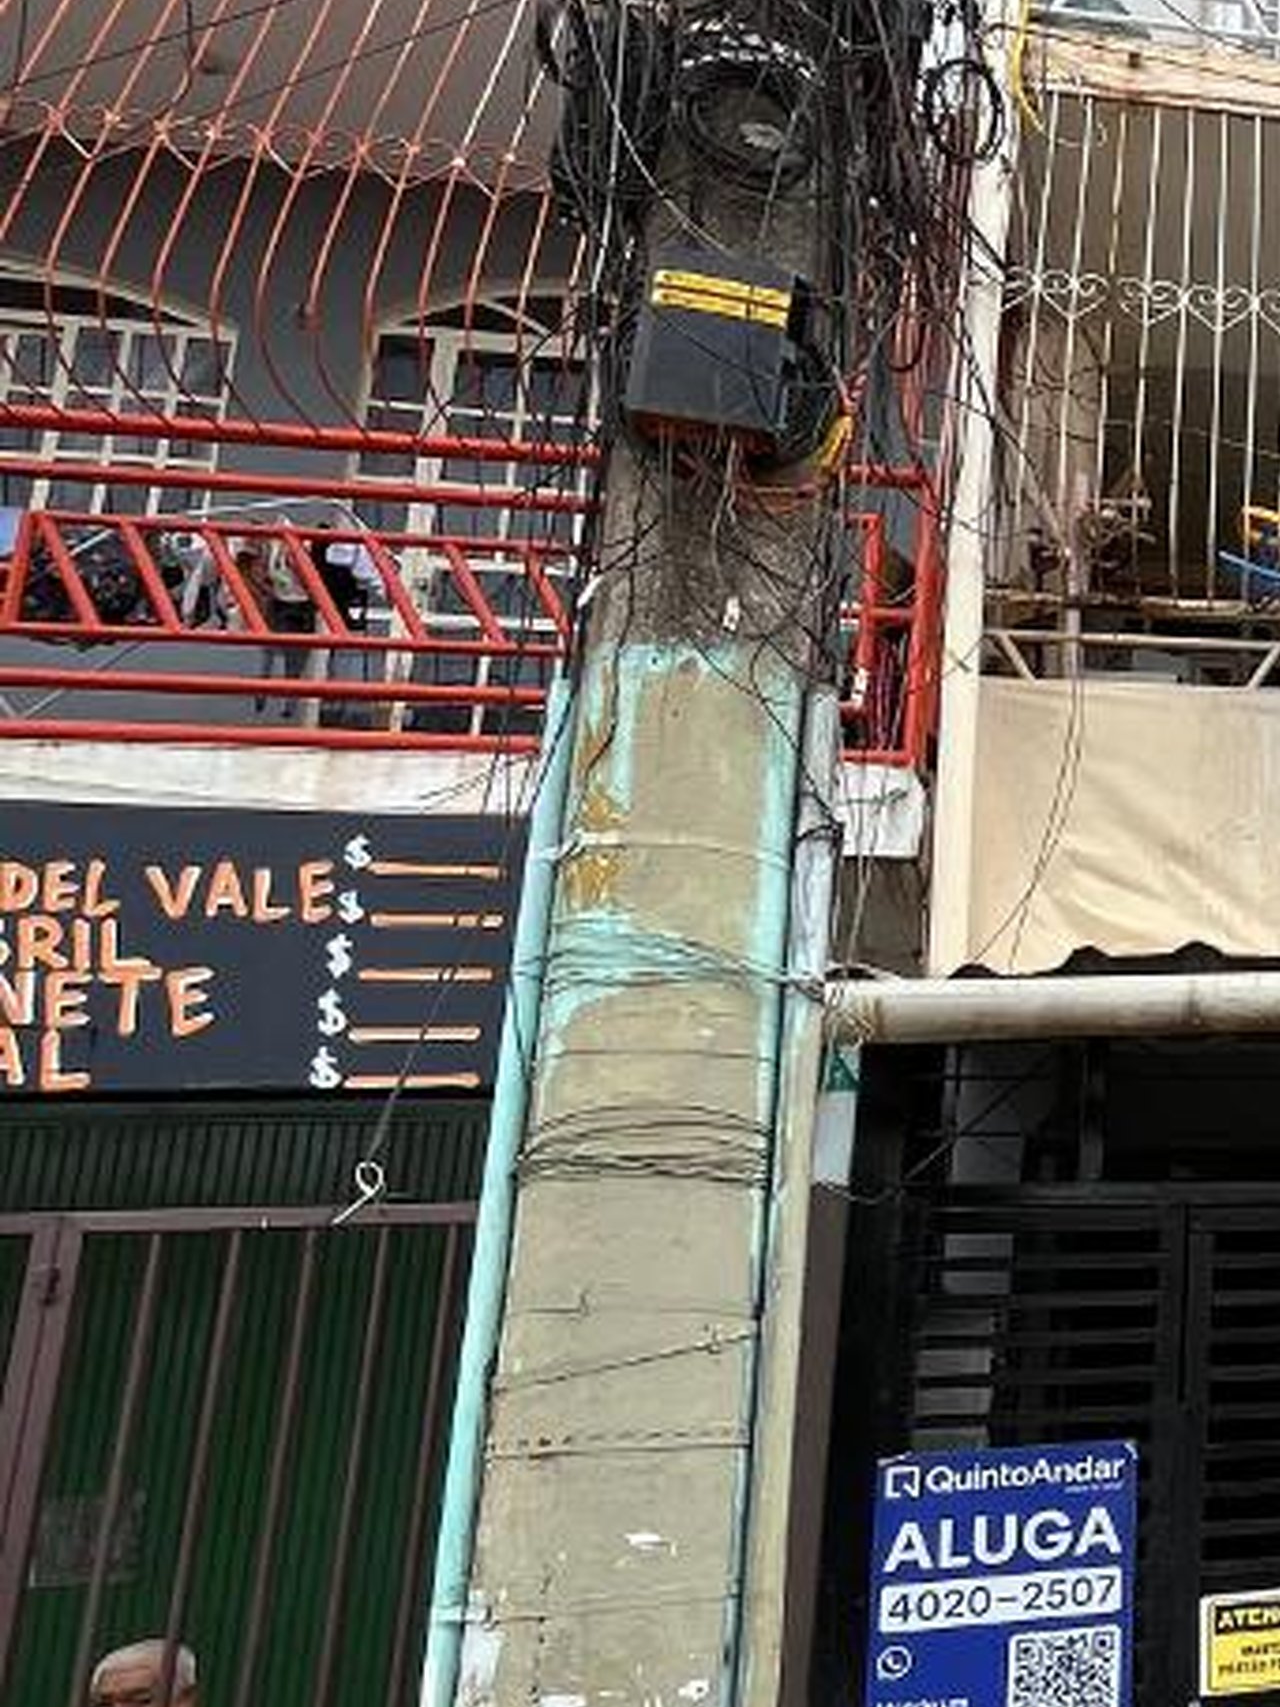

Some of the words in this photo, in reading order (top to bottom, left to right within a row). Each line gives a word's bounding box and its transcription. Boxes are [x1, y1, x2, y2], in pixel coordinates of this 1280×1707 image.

[145, 860, 336, 924] VALE
[0, 914, 153, 969] RIL
[925, 1455, 1125, 1493] QuintoAndar
[883, 1506, 1123, 1573] ALUGA
[887, 1575, 1118, 1623] 4020-2507
